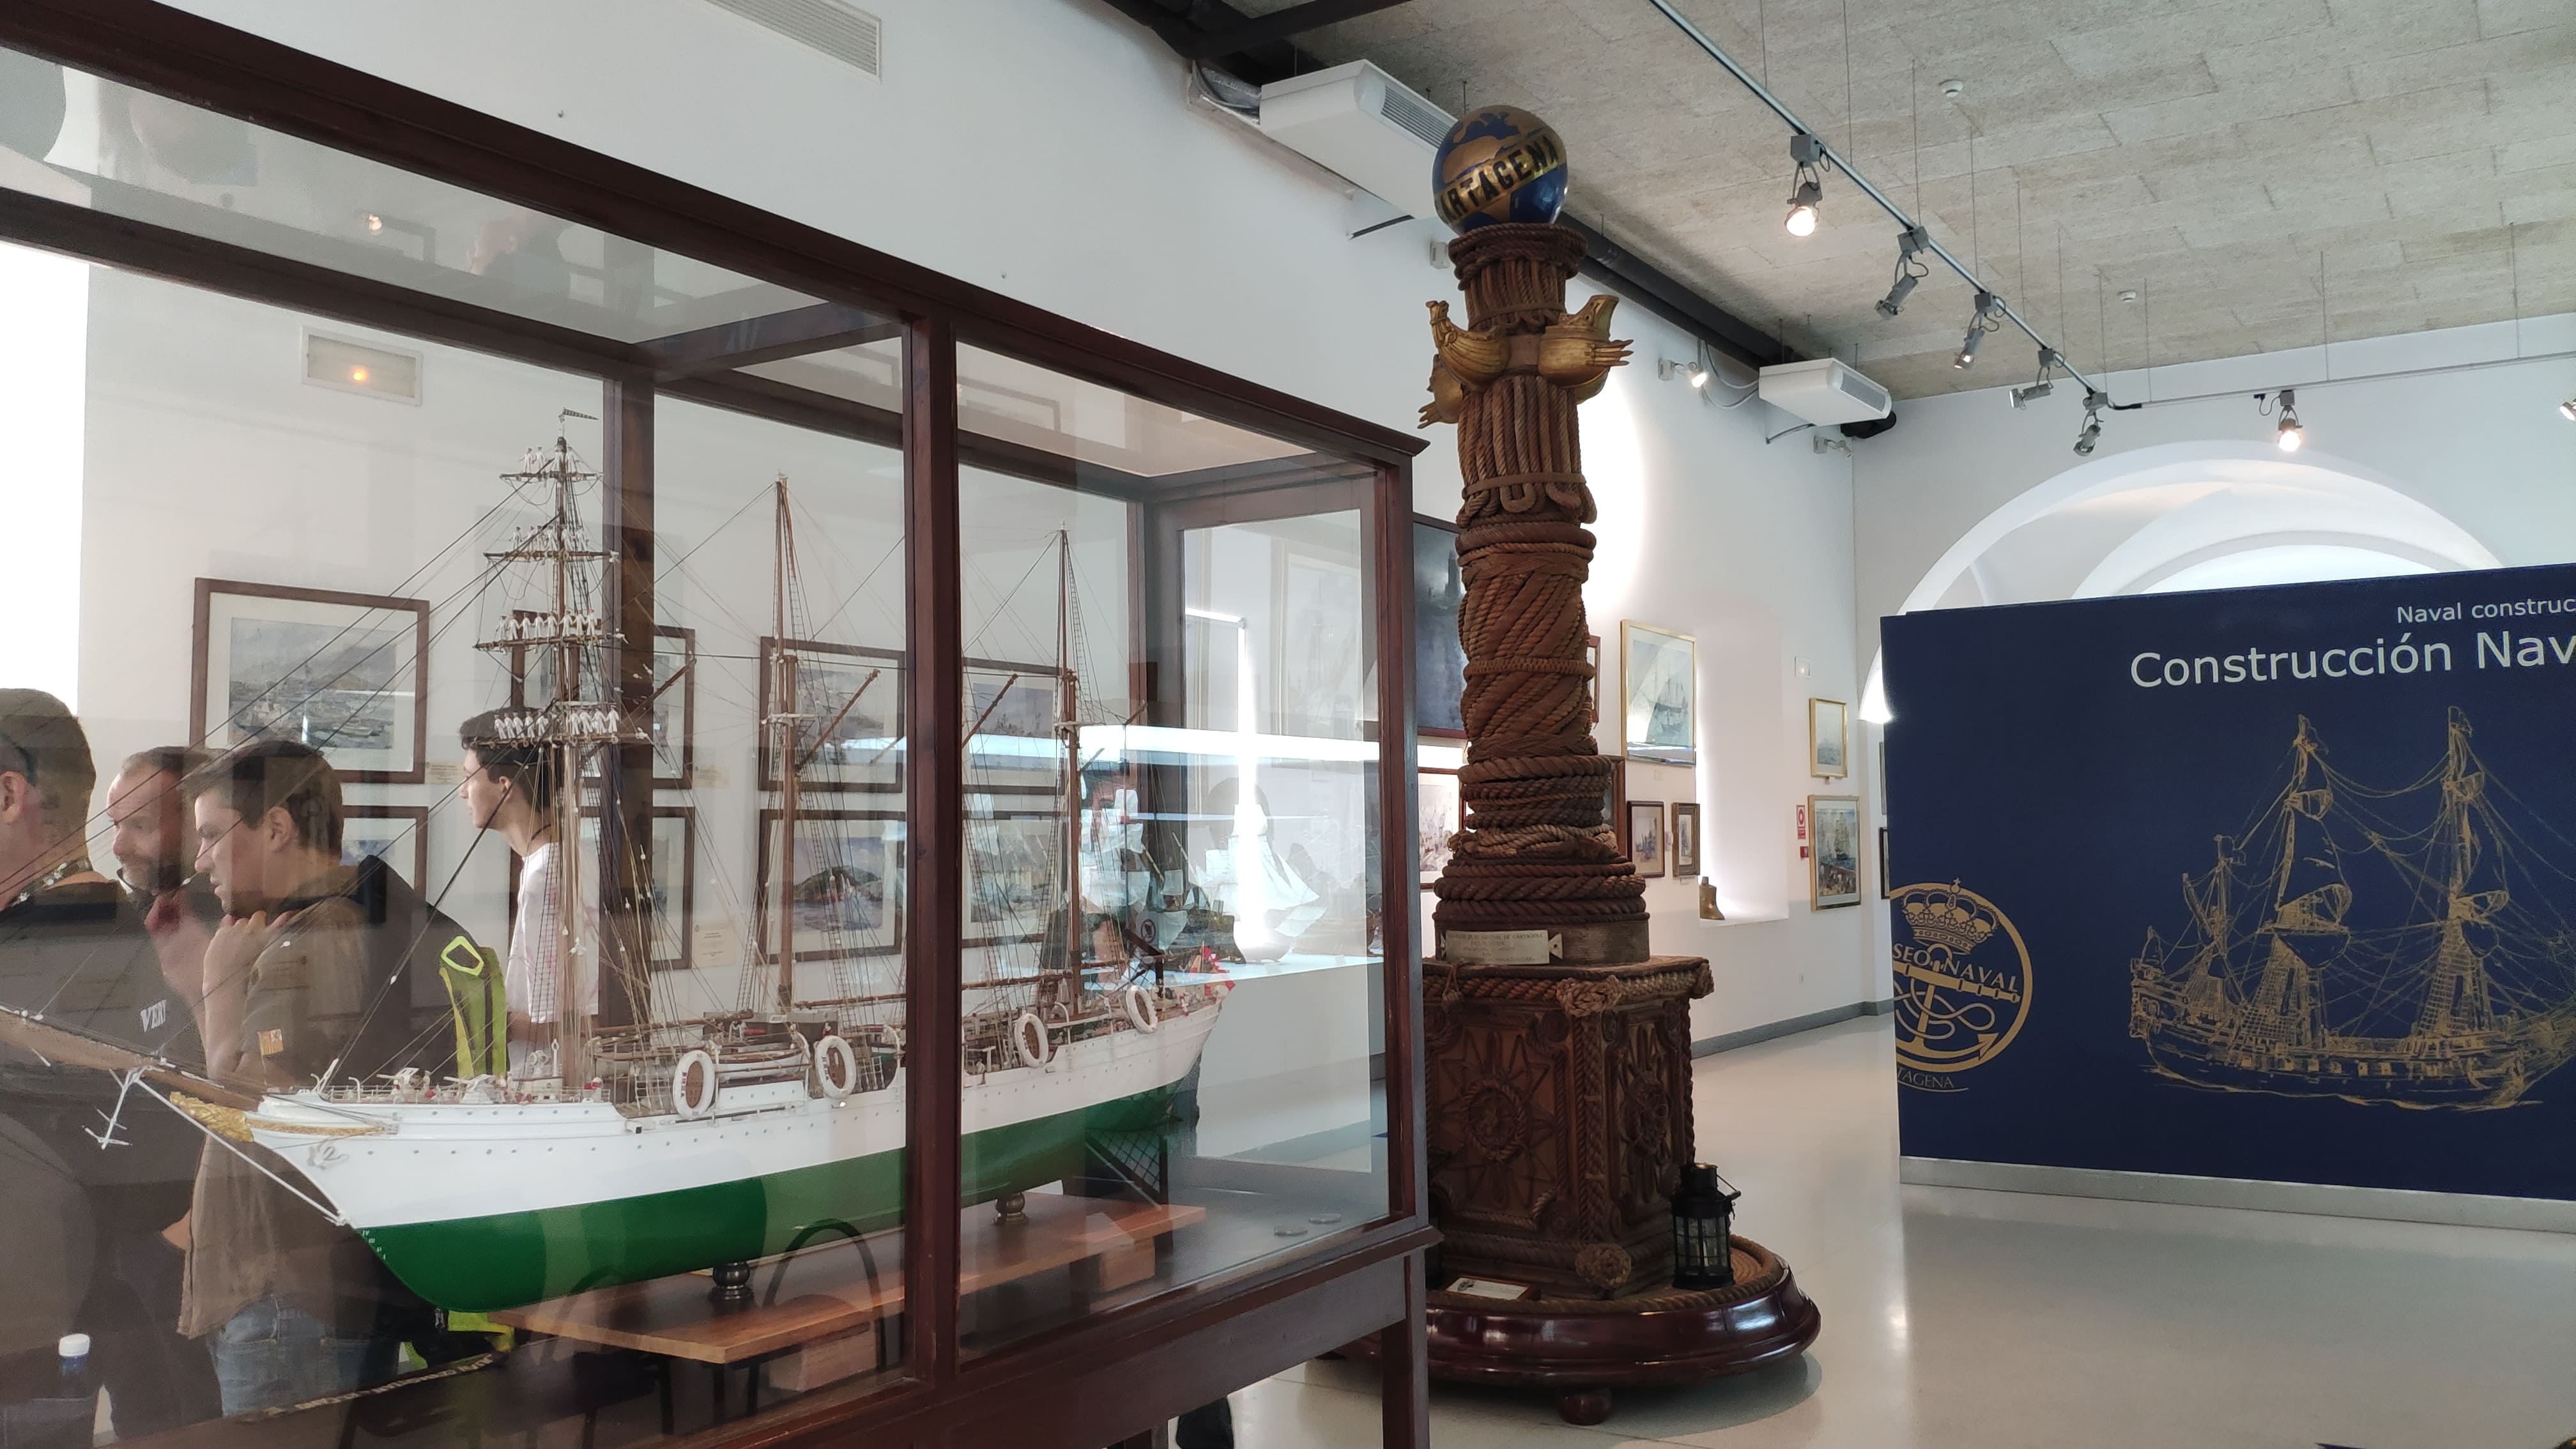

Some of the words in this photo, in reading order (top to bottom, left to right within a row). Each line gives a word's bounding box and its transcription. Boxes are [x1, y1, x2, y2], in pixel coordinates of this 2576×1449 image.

[2397, 602, 2462, 624] Naval
[2471, 598, 2576, 618] construc
[2131, 632, 2451, 687] Construcción
[2477, 631, 2576, 669] Nav
[1942, 957, 2018, 993] NAVAL
